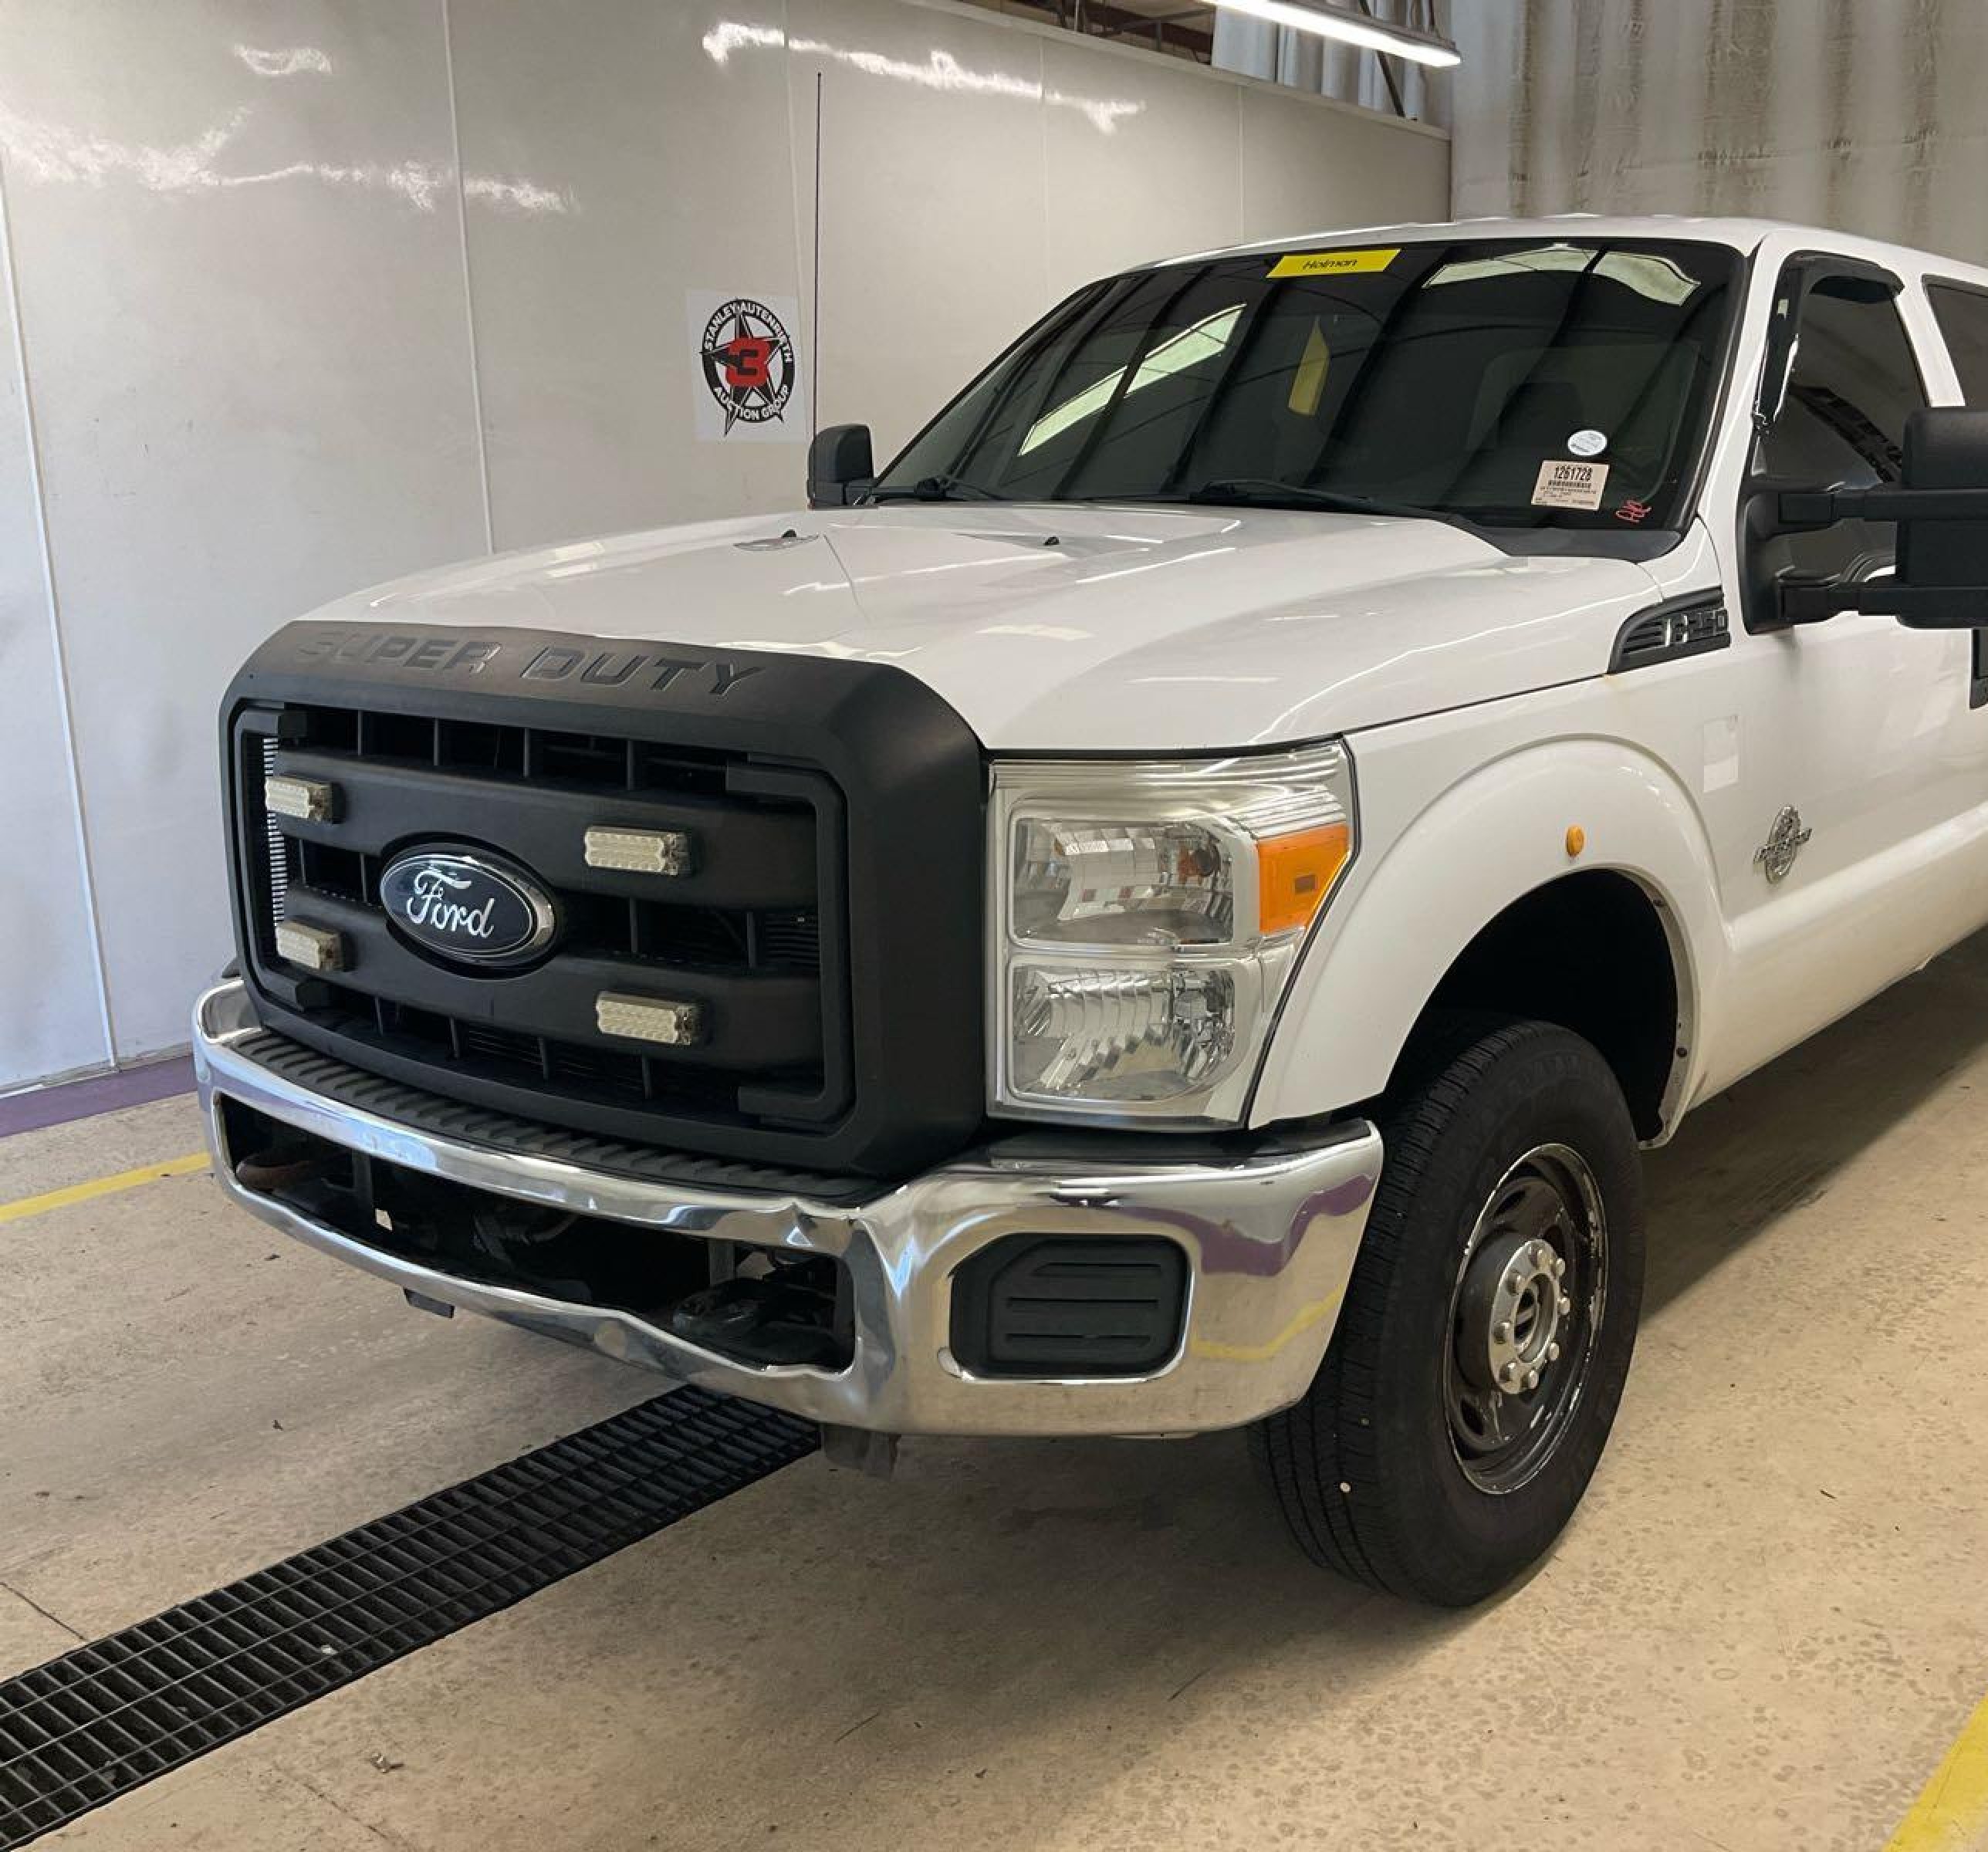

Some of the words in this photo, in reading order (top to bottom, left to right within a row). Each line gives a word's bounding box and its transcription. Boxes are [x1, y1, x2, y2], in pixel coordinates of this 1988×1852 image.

[725, 336, 771, 387] 3
[296, 630, 502, 674] SUPER
[519, 645, 765, 697] DUTY
[406, 869, 495, 938] Ford
